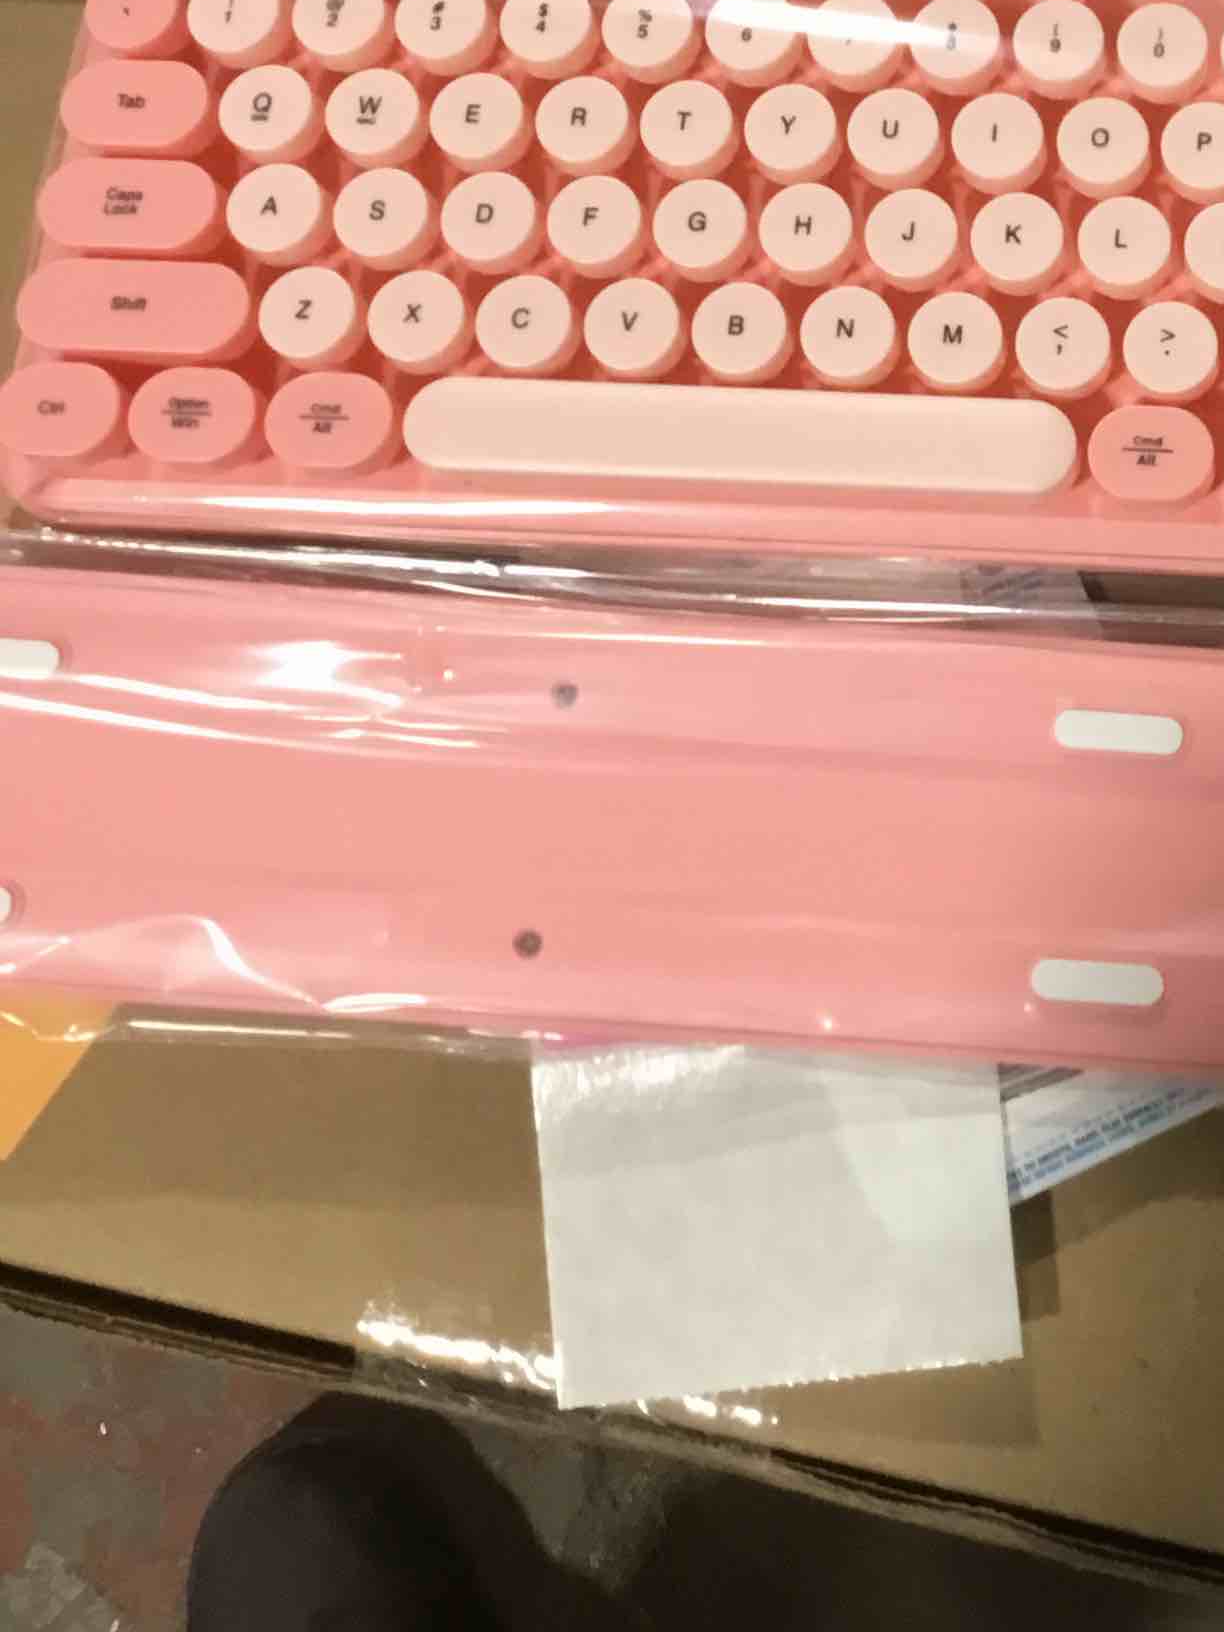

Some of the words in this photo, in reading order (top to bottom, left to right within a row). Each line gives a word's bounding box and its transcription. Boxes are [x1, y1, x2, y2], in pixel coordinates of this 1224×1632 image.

[119, 94, 145, 109] Tab
[253, 93, 272, 114] Q
[359, 97, 382, 115] W
[465, 104, 480, 123] E
[571, 107, 587, 126] R
[677, 111, 692, 131] T
[781, 116, 796, 135] Y
[882, 120, 899, 139] U
[1091, 128, 1110, 148] O
[1197, 132, 1212, 151] P
[261, 197, 277, 215] A
[369, 200, 385, 221] S
[475, 203, 494, 224] D
[582, 207, 599, 226] F
[688, 211, 706, 232] G
[794, 216, 812, 235] H
[901, 221, 915, 242] J
[1005, 225, 1021, 244] K
[1114, 229, 1127, 249] L
[295, 299, 312, 320] Z
[404, 304, 421, 323] X
[511, 307, 530, 329] C
[622, 312, 638, 331] V
[728, 315, 744, 335] B
[837, 319, 854, 338] N
[943, 325, 962, 344] M
